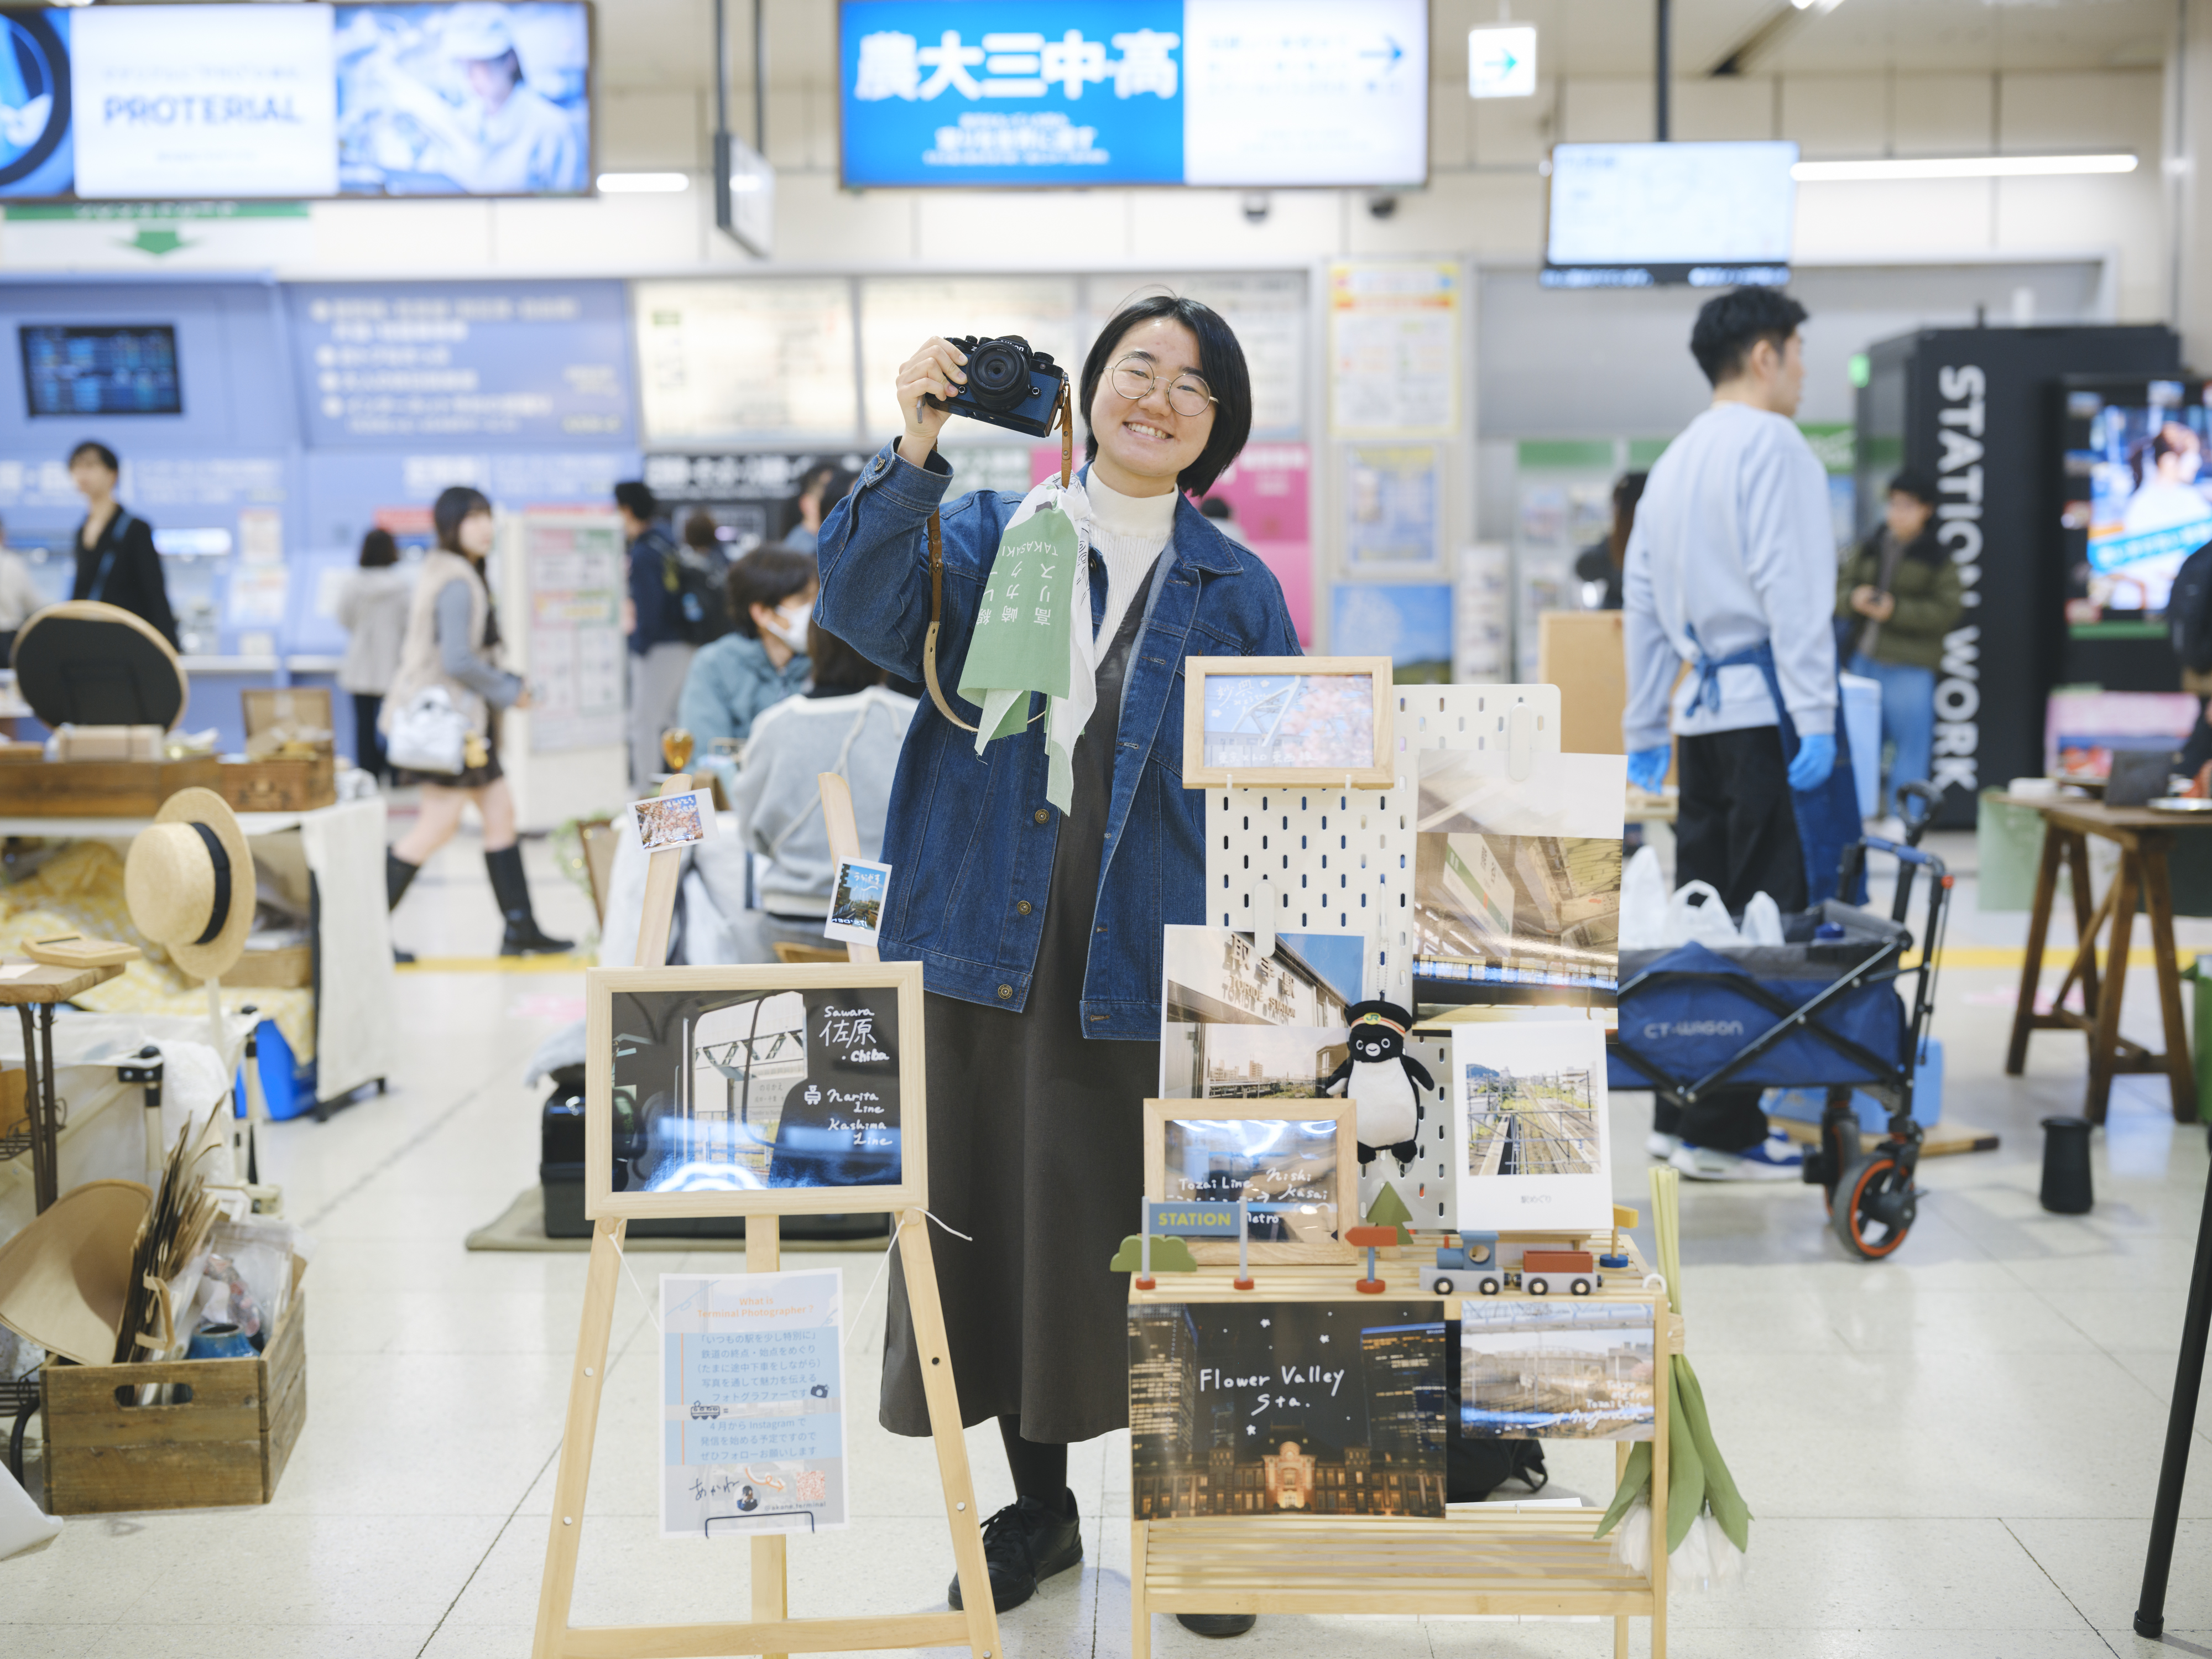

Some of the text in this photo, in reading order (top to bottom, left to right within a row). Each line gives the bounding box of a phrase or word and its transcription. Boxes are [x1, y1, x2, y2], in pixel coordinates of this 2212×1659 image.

[104, 93, 302, 125] PROTERIAL
[1001, 541, 1058, 557] TAKASAKI
[1217, 679, 1254, 707] 妙典
[1932, 624, 1981, 791] WORK
[1231, 933, 1295, 998] 取手駅
[1230, 975, 1295, 1018] TORIDE STATION
[824, 1006, 875, 1018] Sawara
[819, 1018, 877, 1048] 佐原
[759, 1083, 783, 1091] のりかえ
[853, 1101, 885, 1114] Line
[828, 1118, 886, 1131] Kashima
[853, 1132, 893, 1145] Line
[1178, 1176, 1254, 1191] Tozai Line
[1520, 1194, 1552, 1204] 駅めぐり
[1159, 1212, 1231, 1226] STATION
[739, 1296, 774, 1306] What is
[697, 1309, 739, 1318] Terminal
[742, 1306, 806, 1318] Photographer
[701, 1331, 816, 1344] 「いつもの駅を少し特別に」
[701, 1345, 815, 1359] 鉄道の終点・始点をめぐり
[702, 1374, 817, 1389] 写真を通して魅力を伝える
[1200, 1365, 1345, 1397] Flower Valley
[712, 1389, 808, 1402] フォトグラファーです
[1251, 1394, 1310, 1416] Sta.
[750, 1420, 795, 1431] Instagram
[701, 1432, 816, 1447] 発信を始める予定ですので
[701, 1446, 817, 1461] ぜひフォローお願いします
